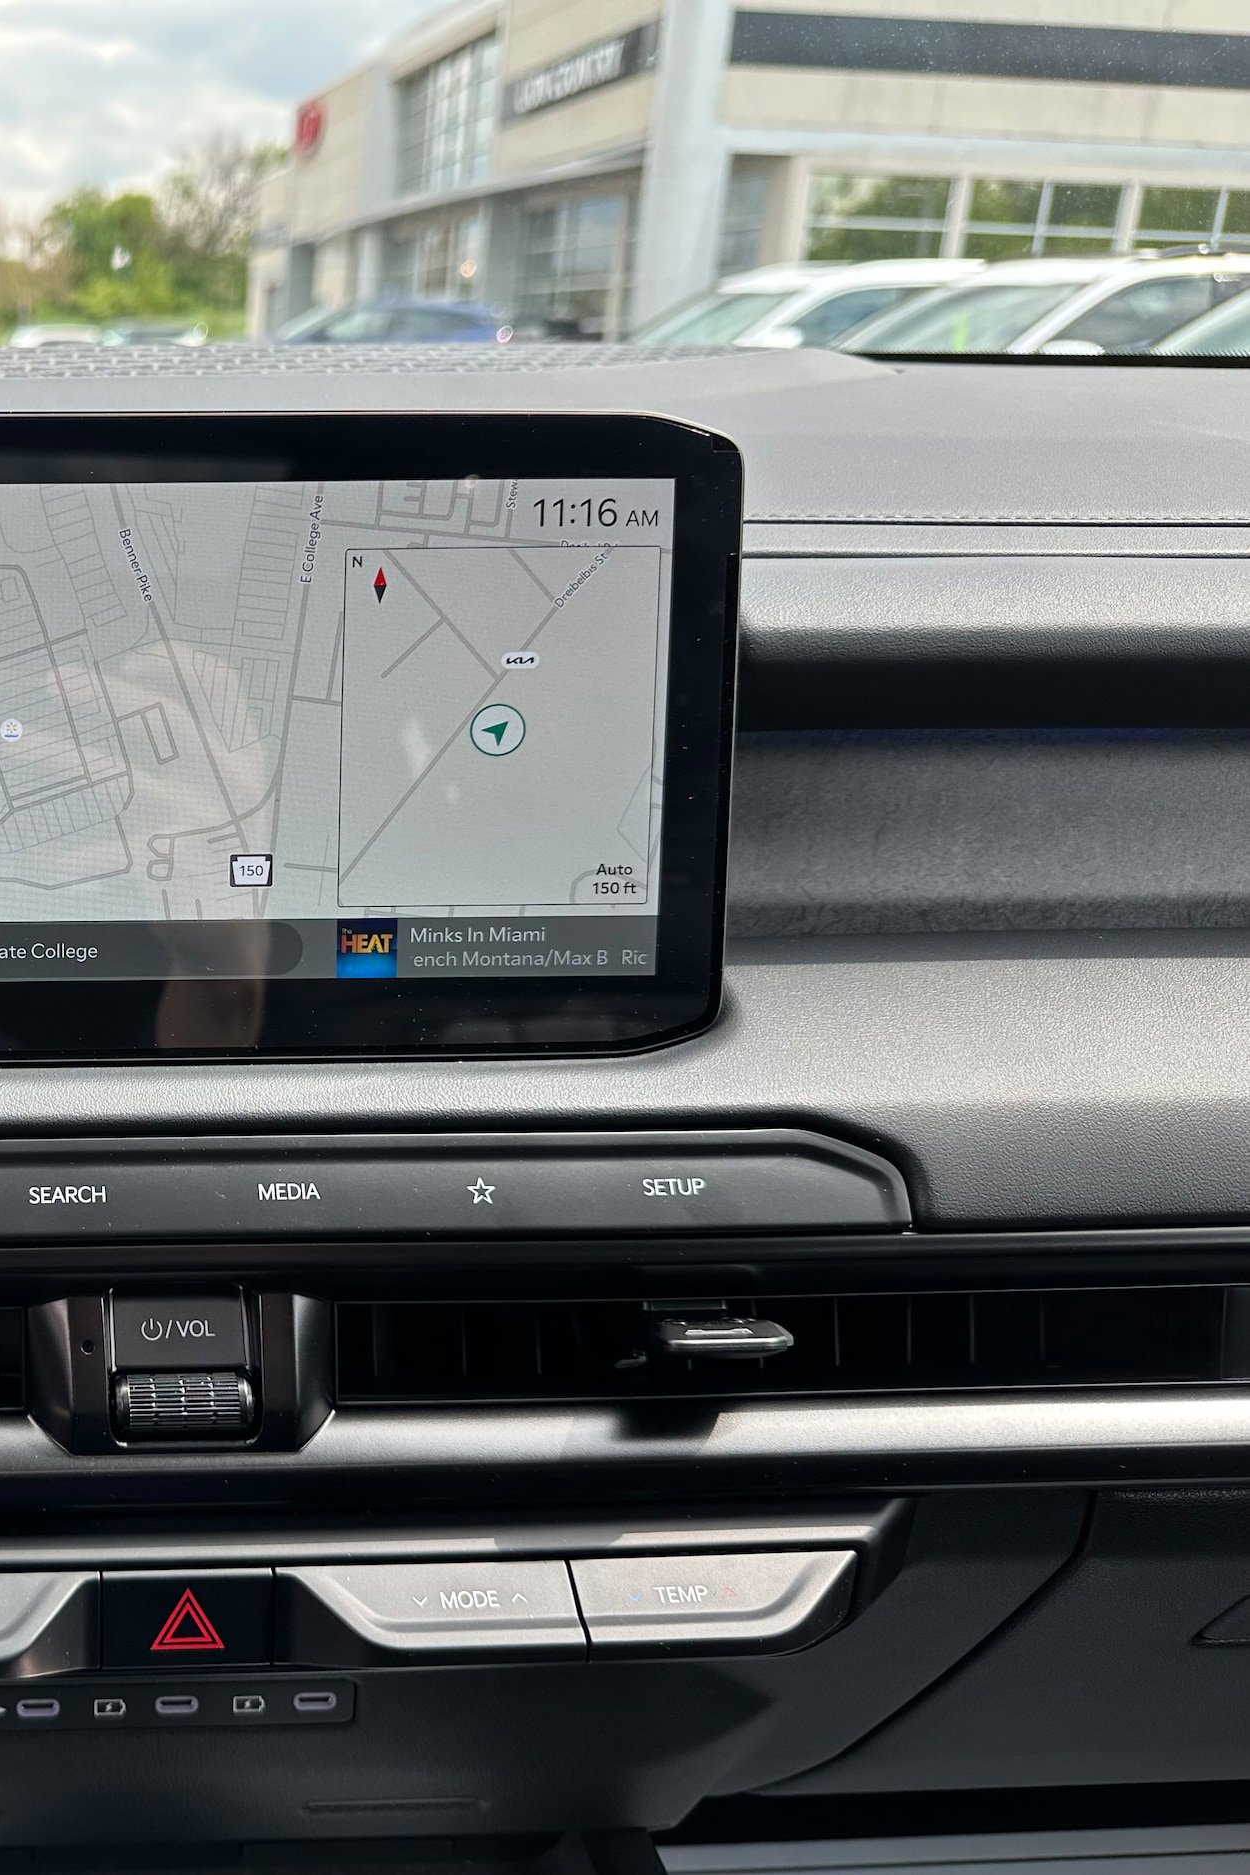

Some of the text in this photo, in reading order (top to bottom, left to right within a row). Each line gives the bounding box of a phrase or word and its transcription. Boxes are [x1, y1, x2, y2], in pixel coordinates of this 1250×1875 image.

[506, 479, 517, 508] Stew
[533, 498, 659, 527] 11:16 AM
[301, 495, 323, 583] E College Ave
[119, 528, 152, 602] Benner Pike
[352, 556, 363, 567] N
[554, 563, 597, 608] Dreibelbis
[595, 553, 608, 565] St
[239, 865, 264, 877] 150
[596, 863, 633, 875] Auto
[592, 881, 637, 894] 150 ft
[341, 933, 394, 954] HEAT
[410, 926, 546, 943] Minks In Miami
[31, 943, 98, 962] College
[410, 950, 647, 967] ench Montana/Max B Ric
[28, 1185, 107, 1205] SEARCH
[257, 1182, 321, 1201] MEDIA
[642, 1177, 706, 1197] SETUP
[439, 1589, 500, 1609] MODE
[653, 1585, 708, 1604] TEMP
